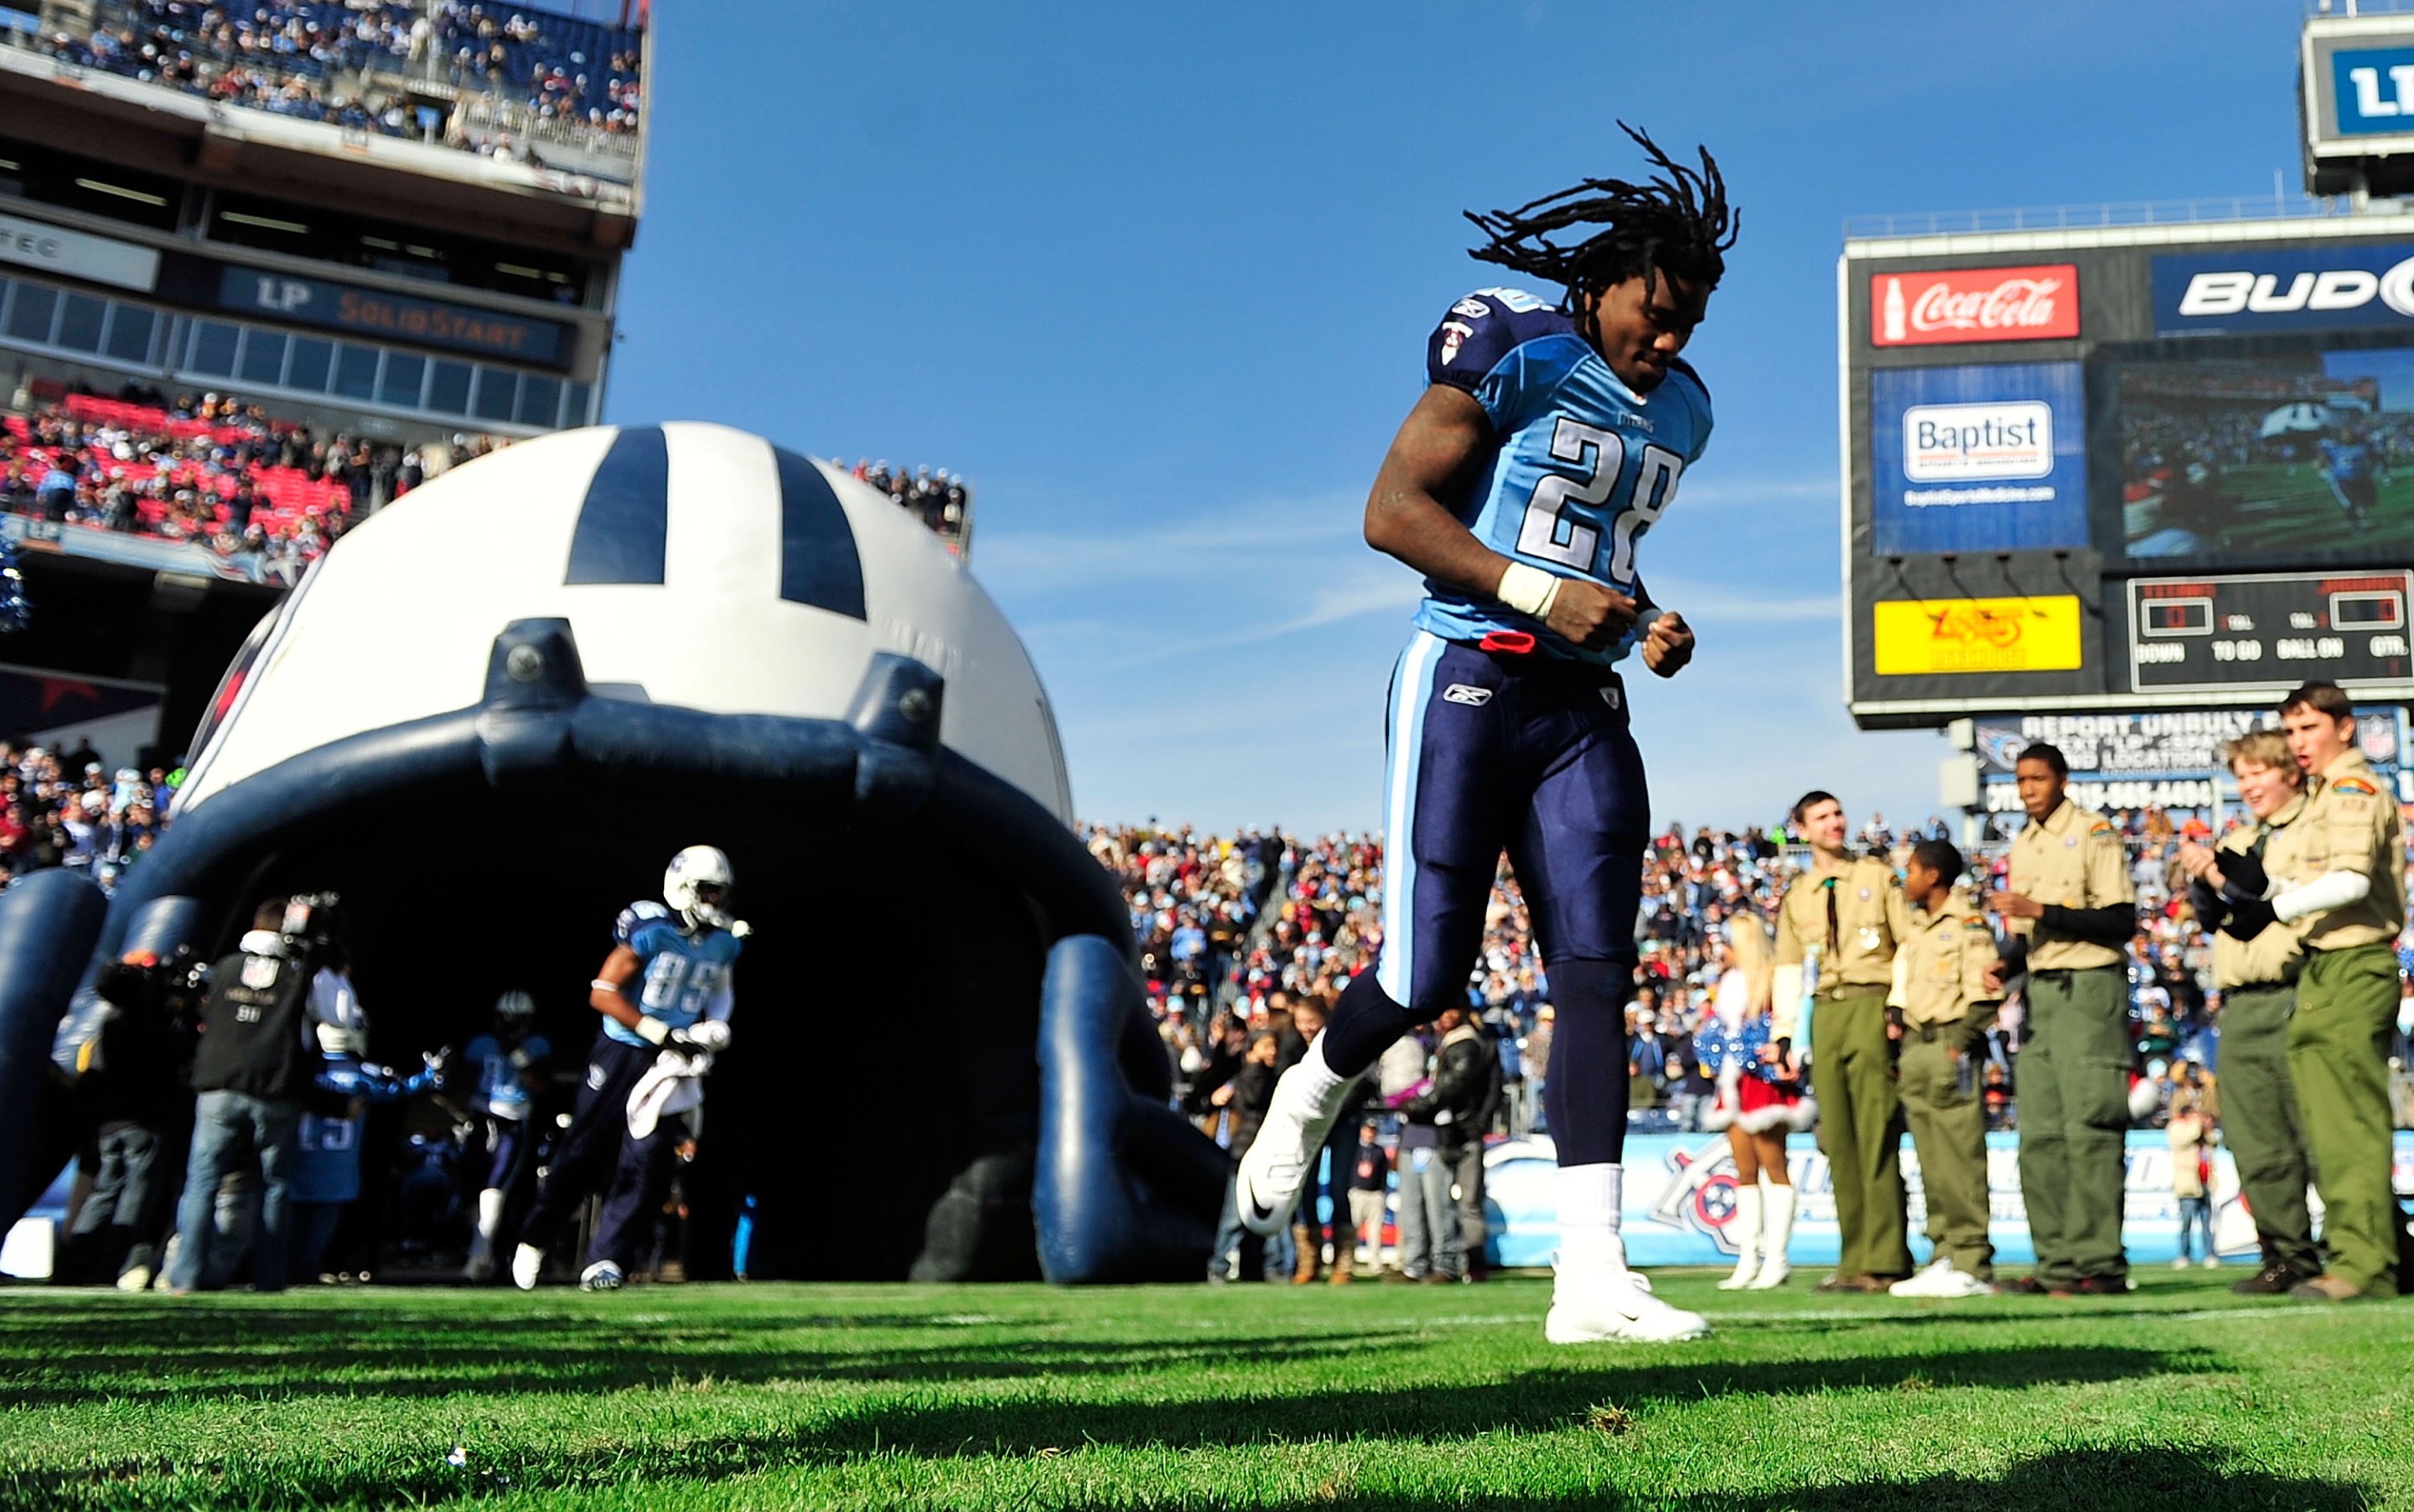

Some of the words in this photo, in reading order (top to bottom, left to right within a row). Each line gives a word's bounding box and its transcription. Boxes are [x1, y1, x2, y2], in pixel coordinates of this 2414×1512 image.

[256, 277, 313, 312] LP
[2178, 270, 2379, 316] BUD
[1918, 416, 2037, 455] Baptist
[1515, 417, 1683, 584] 28
[2137, 642, 2185, 664] DOWN
[2211, 640, 2235, 661] TO
[2236, 639, 2262, 660] GO
[2277, 638, 2318, 660] BALL
[2317, 637, 2344, 659] ON
[2022, 715, 2133, 738] REPORT
[2140, 712, 2255, 737] UNRULY
[2101, 748, 2213, 769] LOCATION
